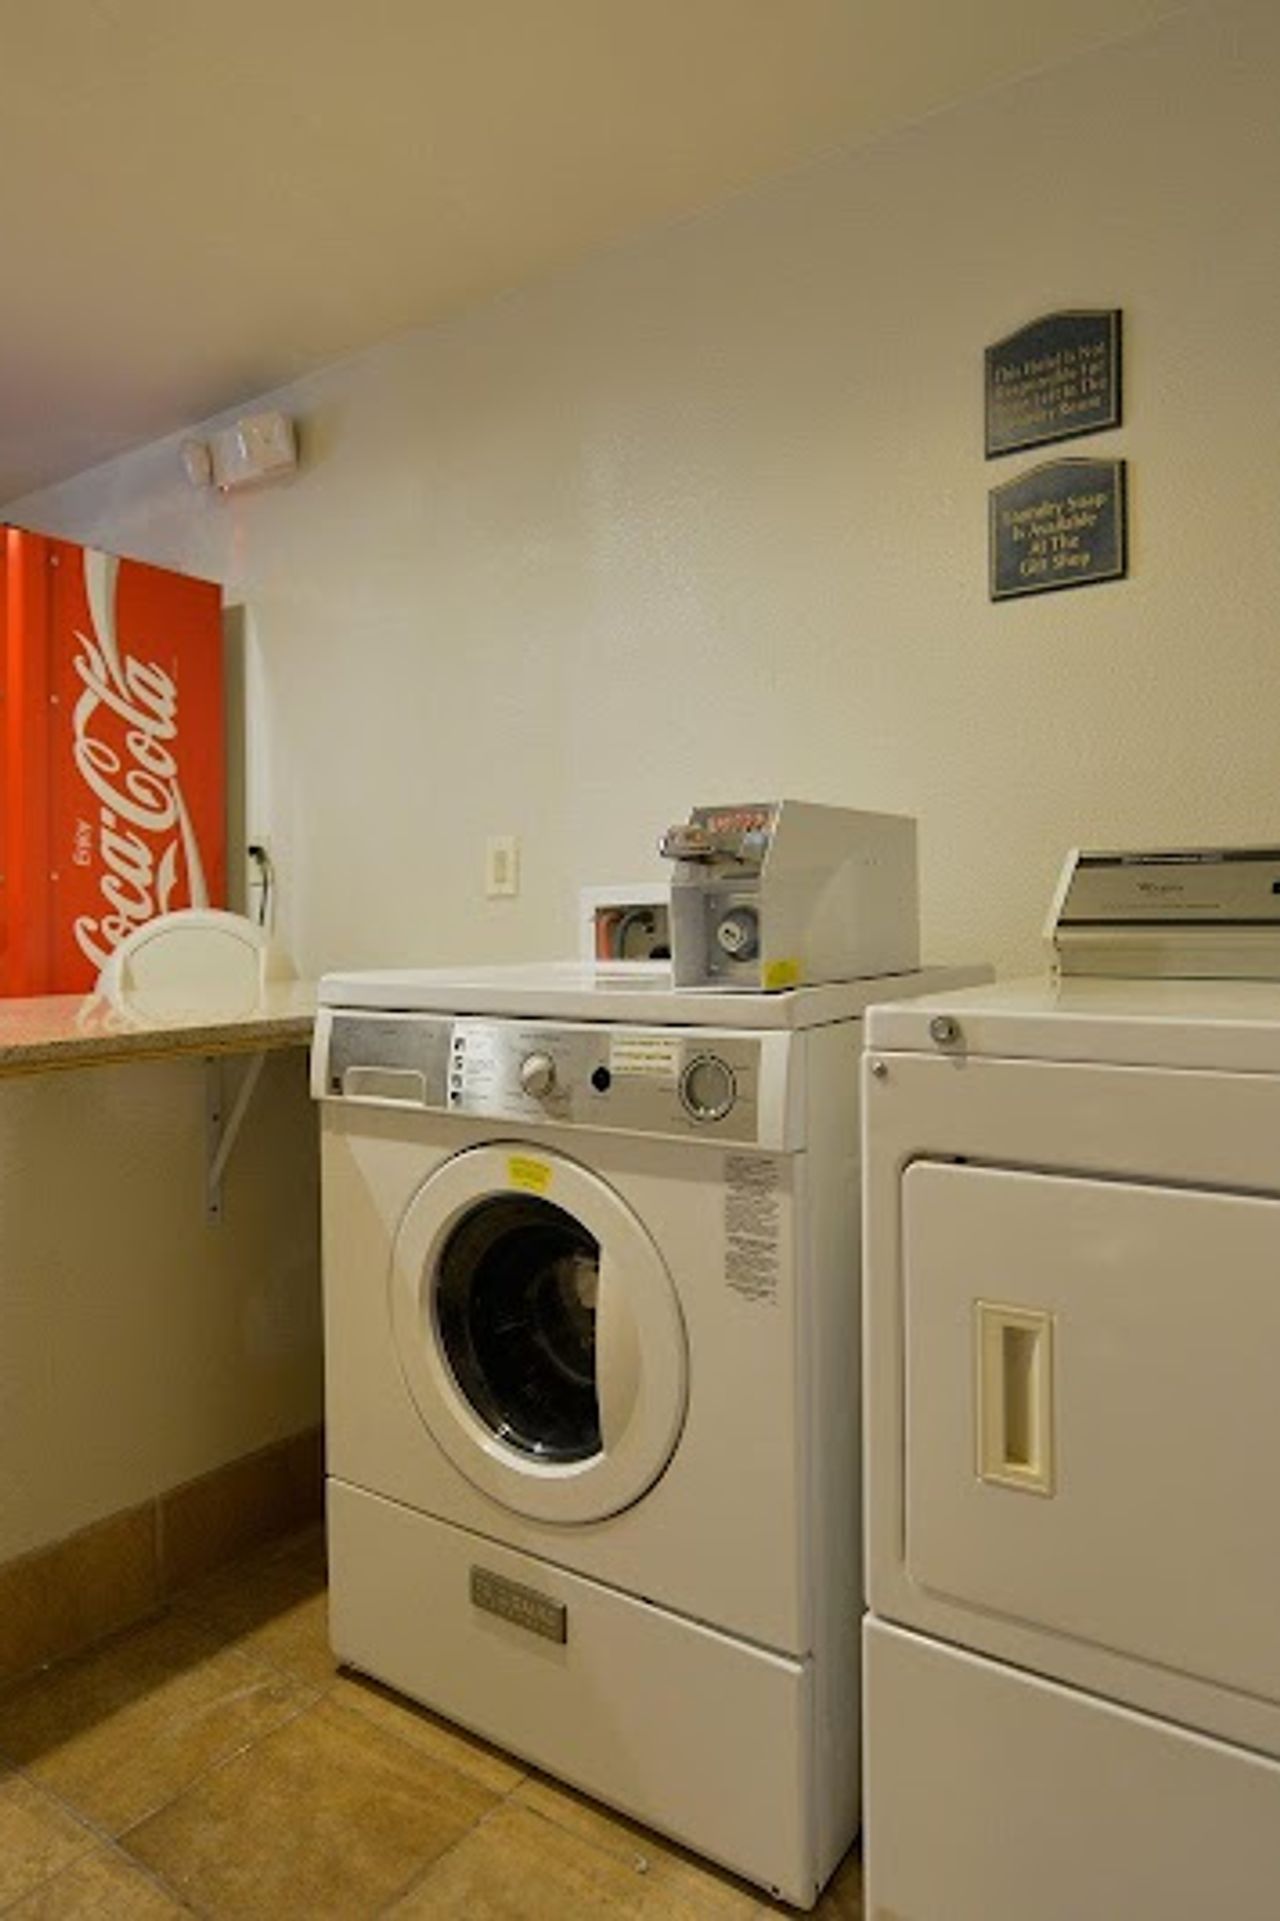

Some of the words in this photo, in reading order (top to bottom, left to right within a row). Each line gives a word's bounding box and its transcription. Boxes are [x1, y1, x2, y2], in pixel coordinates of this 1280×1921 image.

[1002, 501, 1062, 524] Laundry
[1067, 494, 1107, 510] Soap
[1028, 512, 1097, 539] Available
[1050, 533, 1080, 550] The
[1020, 557, 1048, 577] Gift
[1052, 552, 1091, 571] Shop
[72, 818, 92, 867] Enjoy
